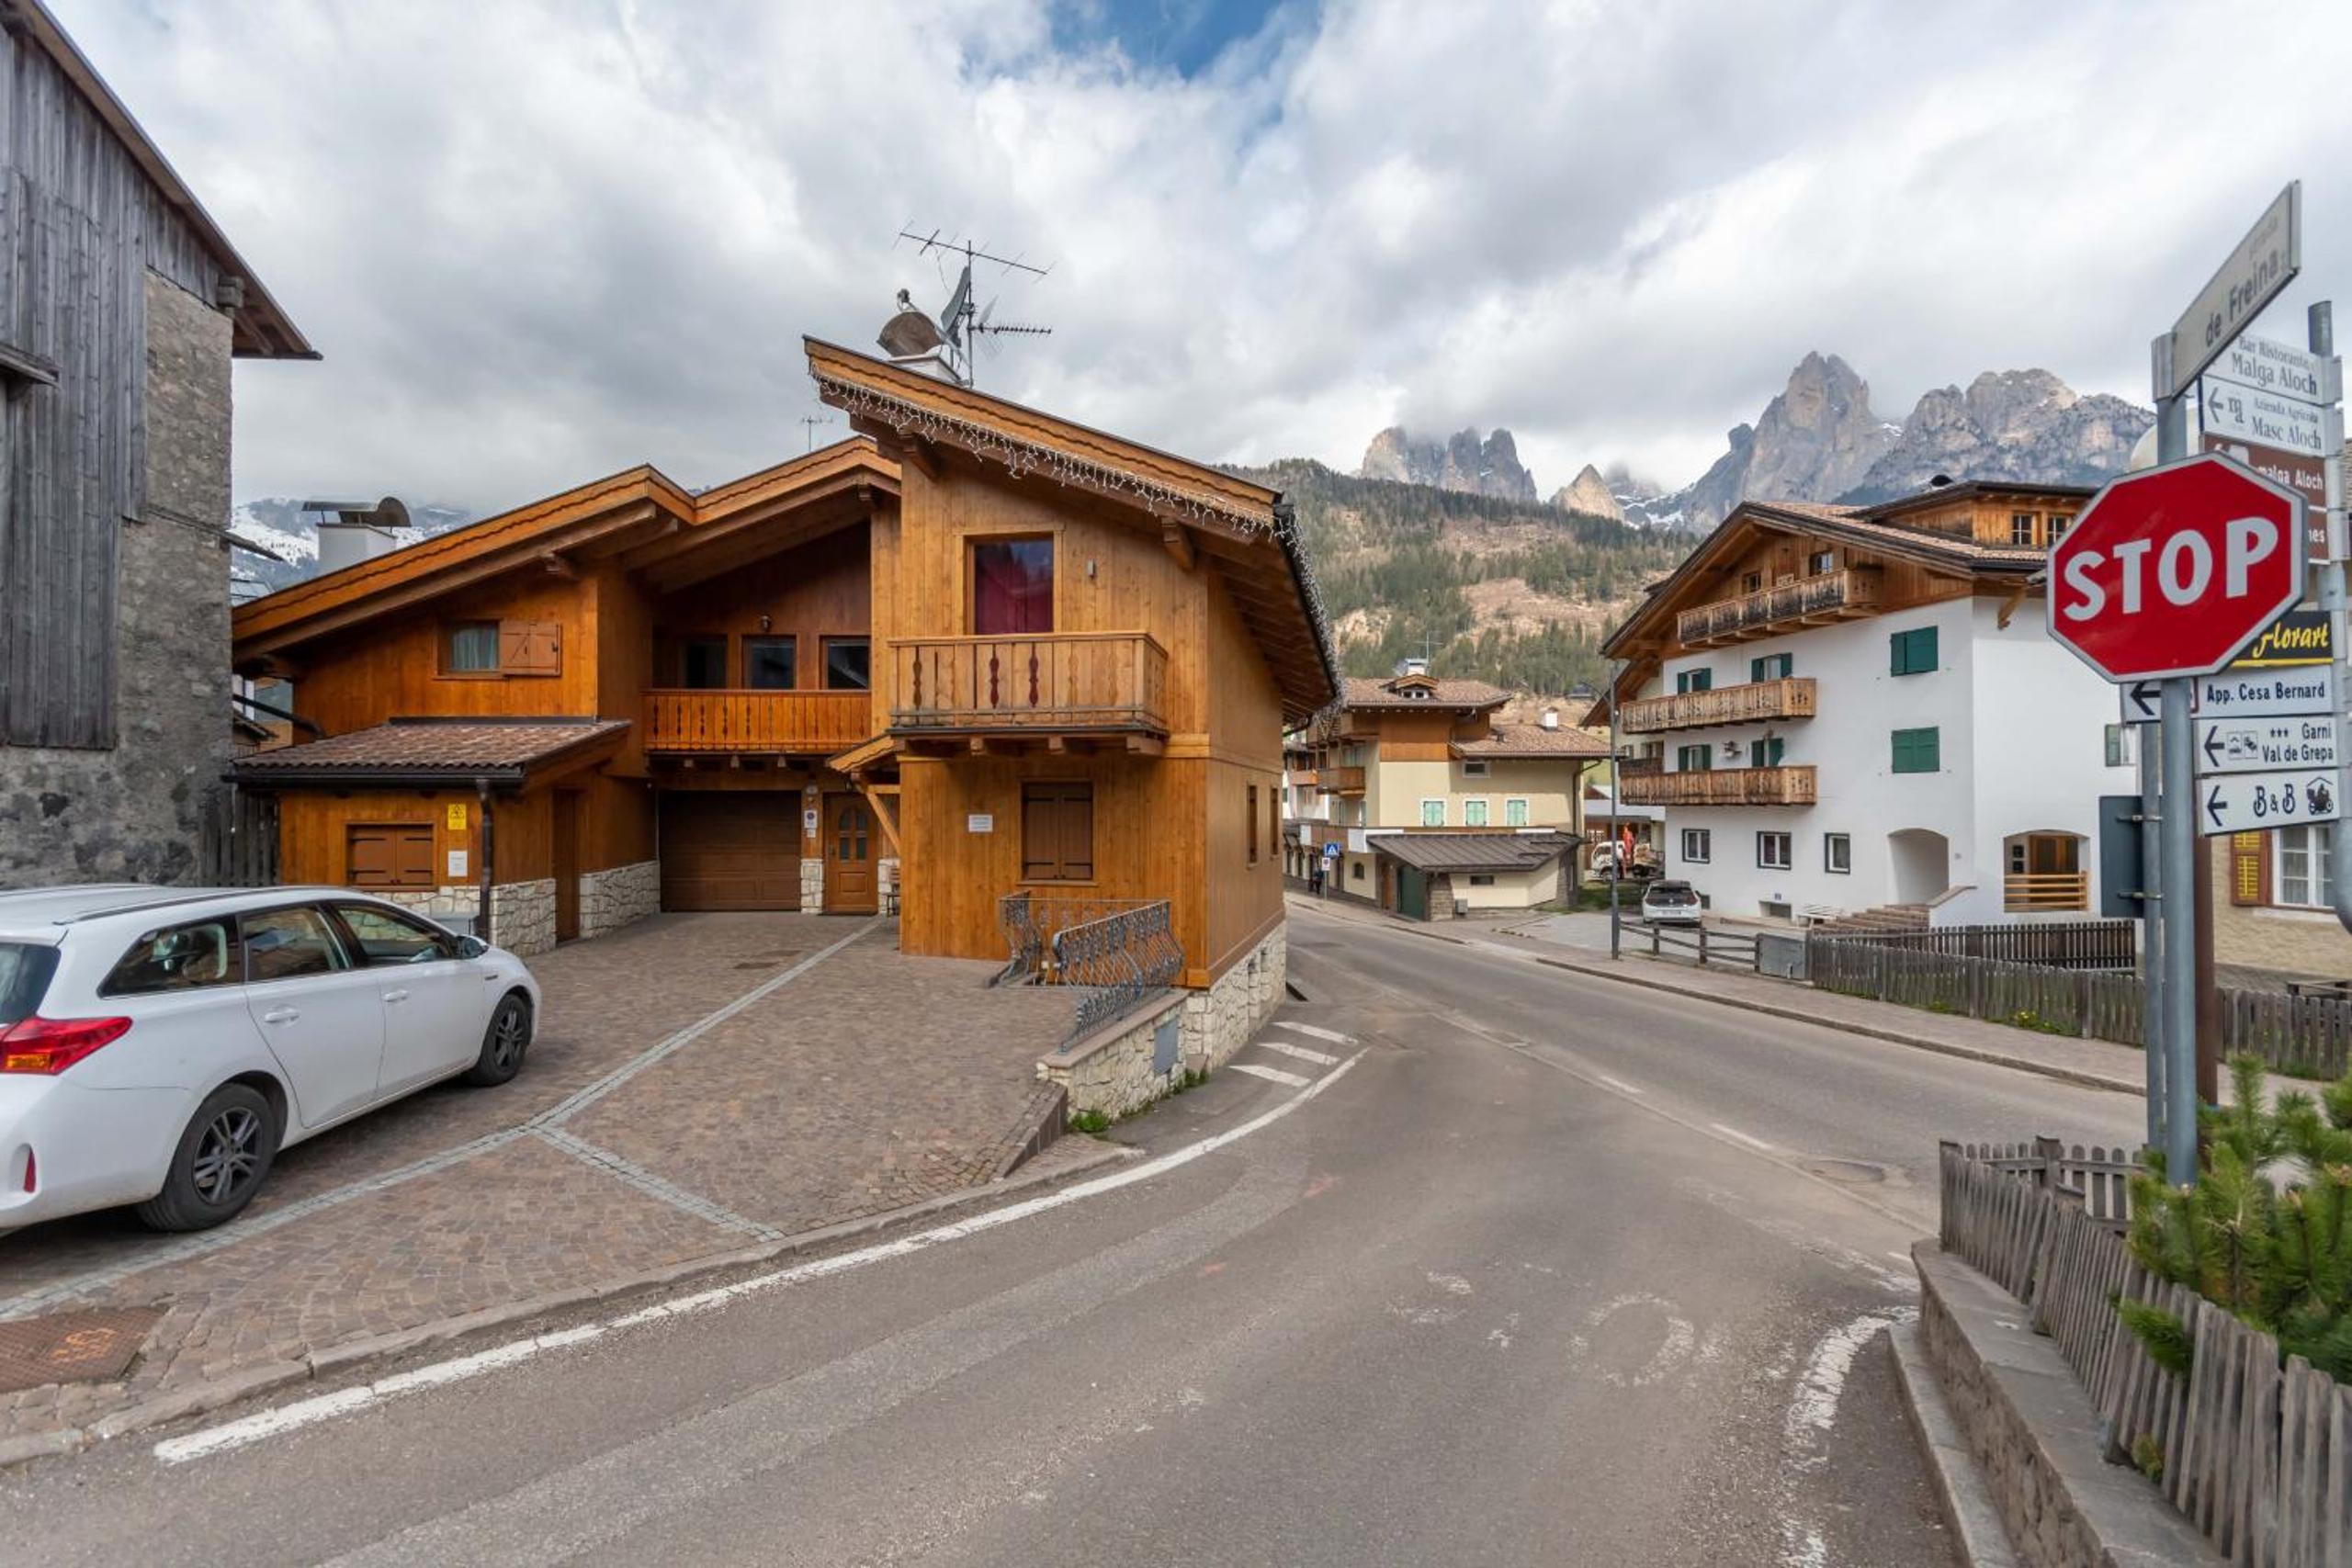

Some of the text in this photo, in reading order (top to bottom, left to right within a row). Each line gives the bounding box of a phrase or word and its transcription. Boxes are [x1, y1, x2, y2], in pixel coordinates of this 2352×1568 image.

[2205, 310, 2222, 347] de
[2228, 249, 2278, 322] Freina
[2232, 352, 2317, 396] Malga Aloch
[2252, 415, 2323, 450] Masc Aloch
[2294, 468, 2324, 490] Aloch
[2064, 516, 2278, 622] STOP
[2207, 680, 2325, 705] App. Cesa Bernard
[2301, 721, 2332, 740] Garni
[2262, 743, 2335, 765] Val de Grepa
[2269, 793, 2279, 815] &
